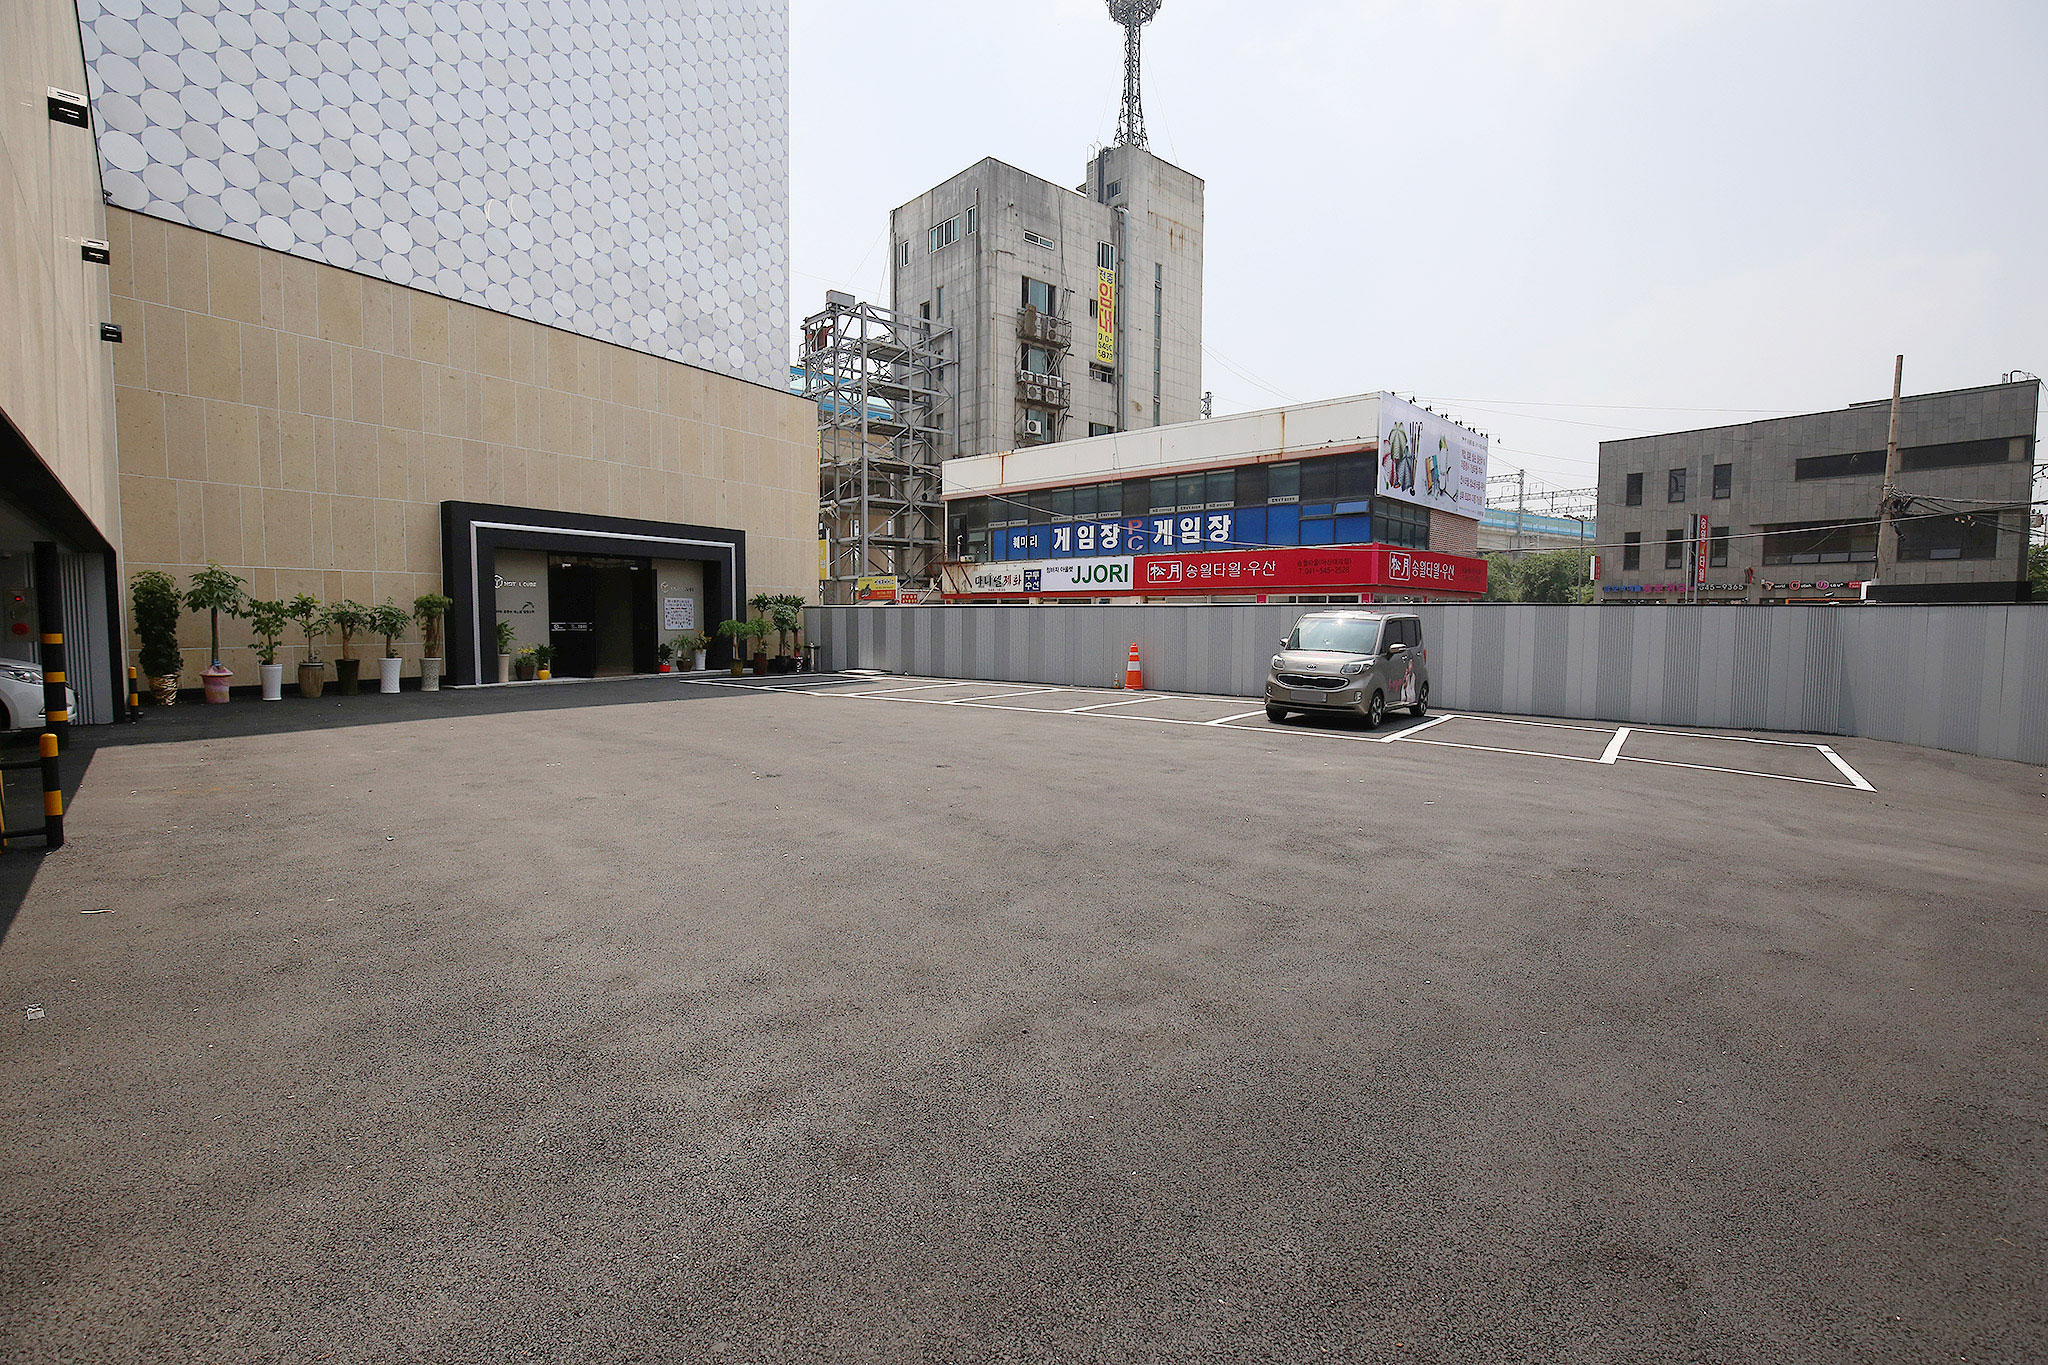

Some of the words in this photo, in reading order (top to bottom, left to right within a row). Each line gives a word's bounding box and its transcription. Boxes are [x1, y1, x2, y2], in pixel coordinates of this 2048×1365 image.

[1099, 283, 1114, 334] 임대
[1053, 522, 1121, 552] 게임장
[1152, 514, 1232, 546] 게임장
[1071, 563, 1129, 584] JJORI
